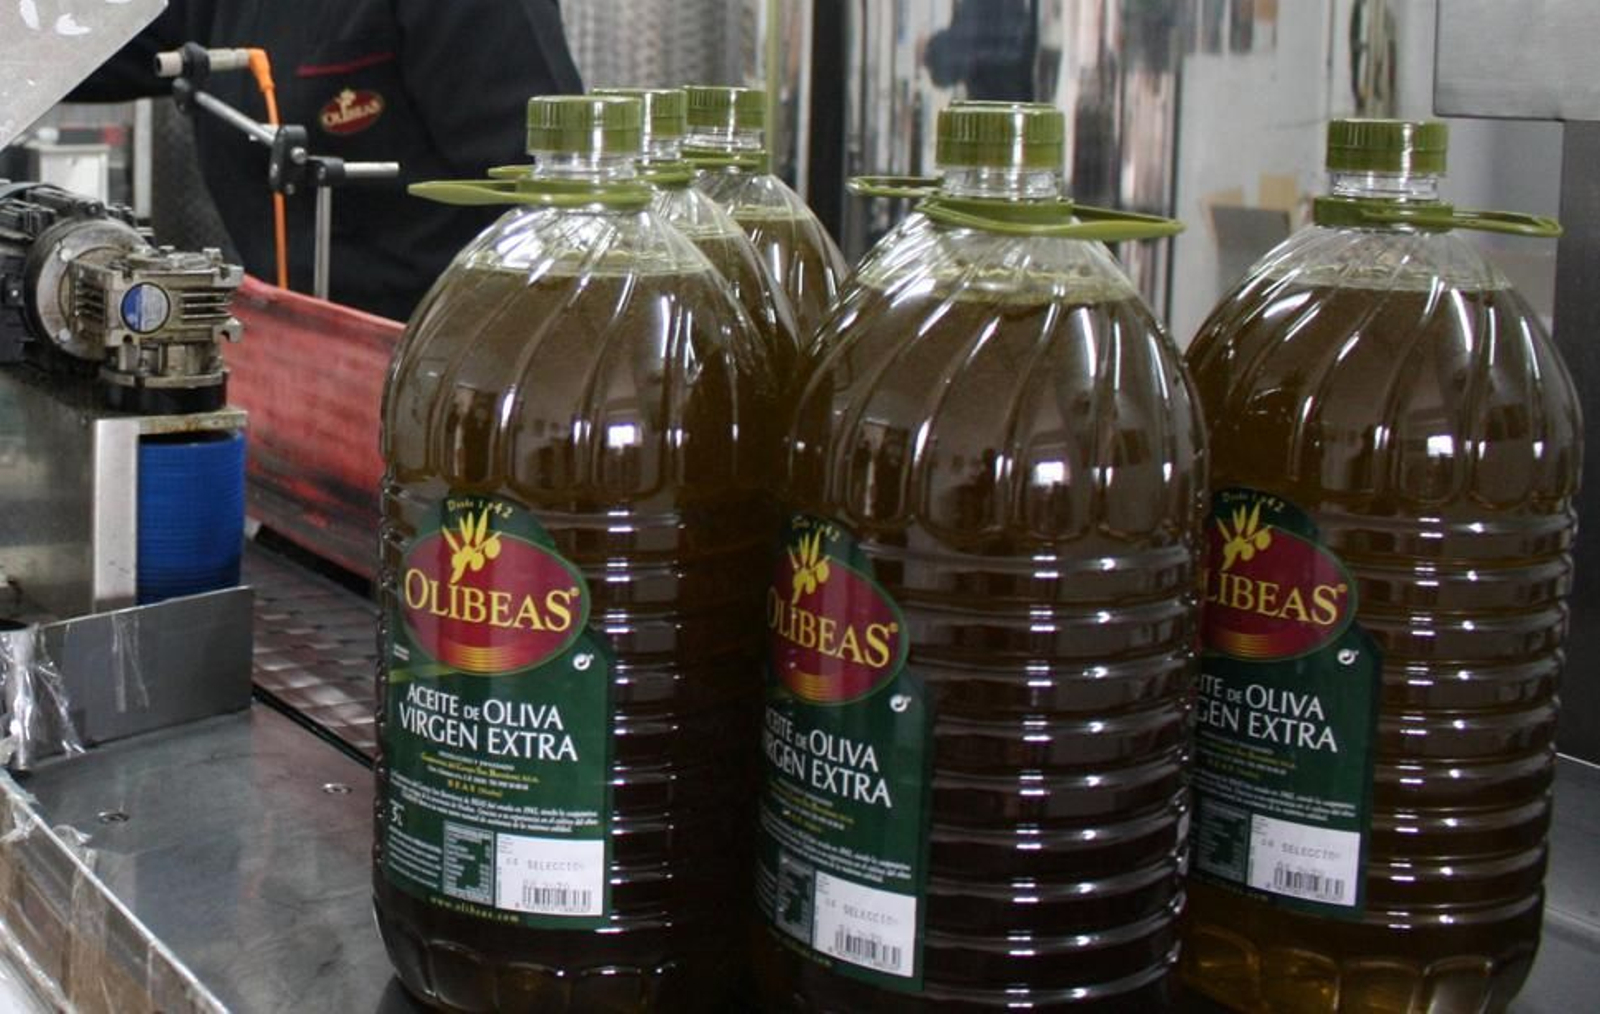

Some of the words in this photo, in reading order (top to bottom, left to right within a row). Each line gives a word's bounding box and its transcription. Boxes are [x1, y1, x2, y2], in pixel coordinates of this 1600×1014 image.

[406, 682, 459, 717] ACEITE
[463, 705, 480, 721] DE
[483, 699, 564, 731] OLIVA
[1246, 684, 1325, 722] OLIVA
[399, 702, 478, 750] VIRGEN
[488, 727, 578, 762] EXTRA
[809, 729, 879, 773] OLIVA
[1248, 712, 1338, 753] EXTRA
[811, 759, 893, 808] EXTRA
